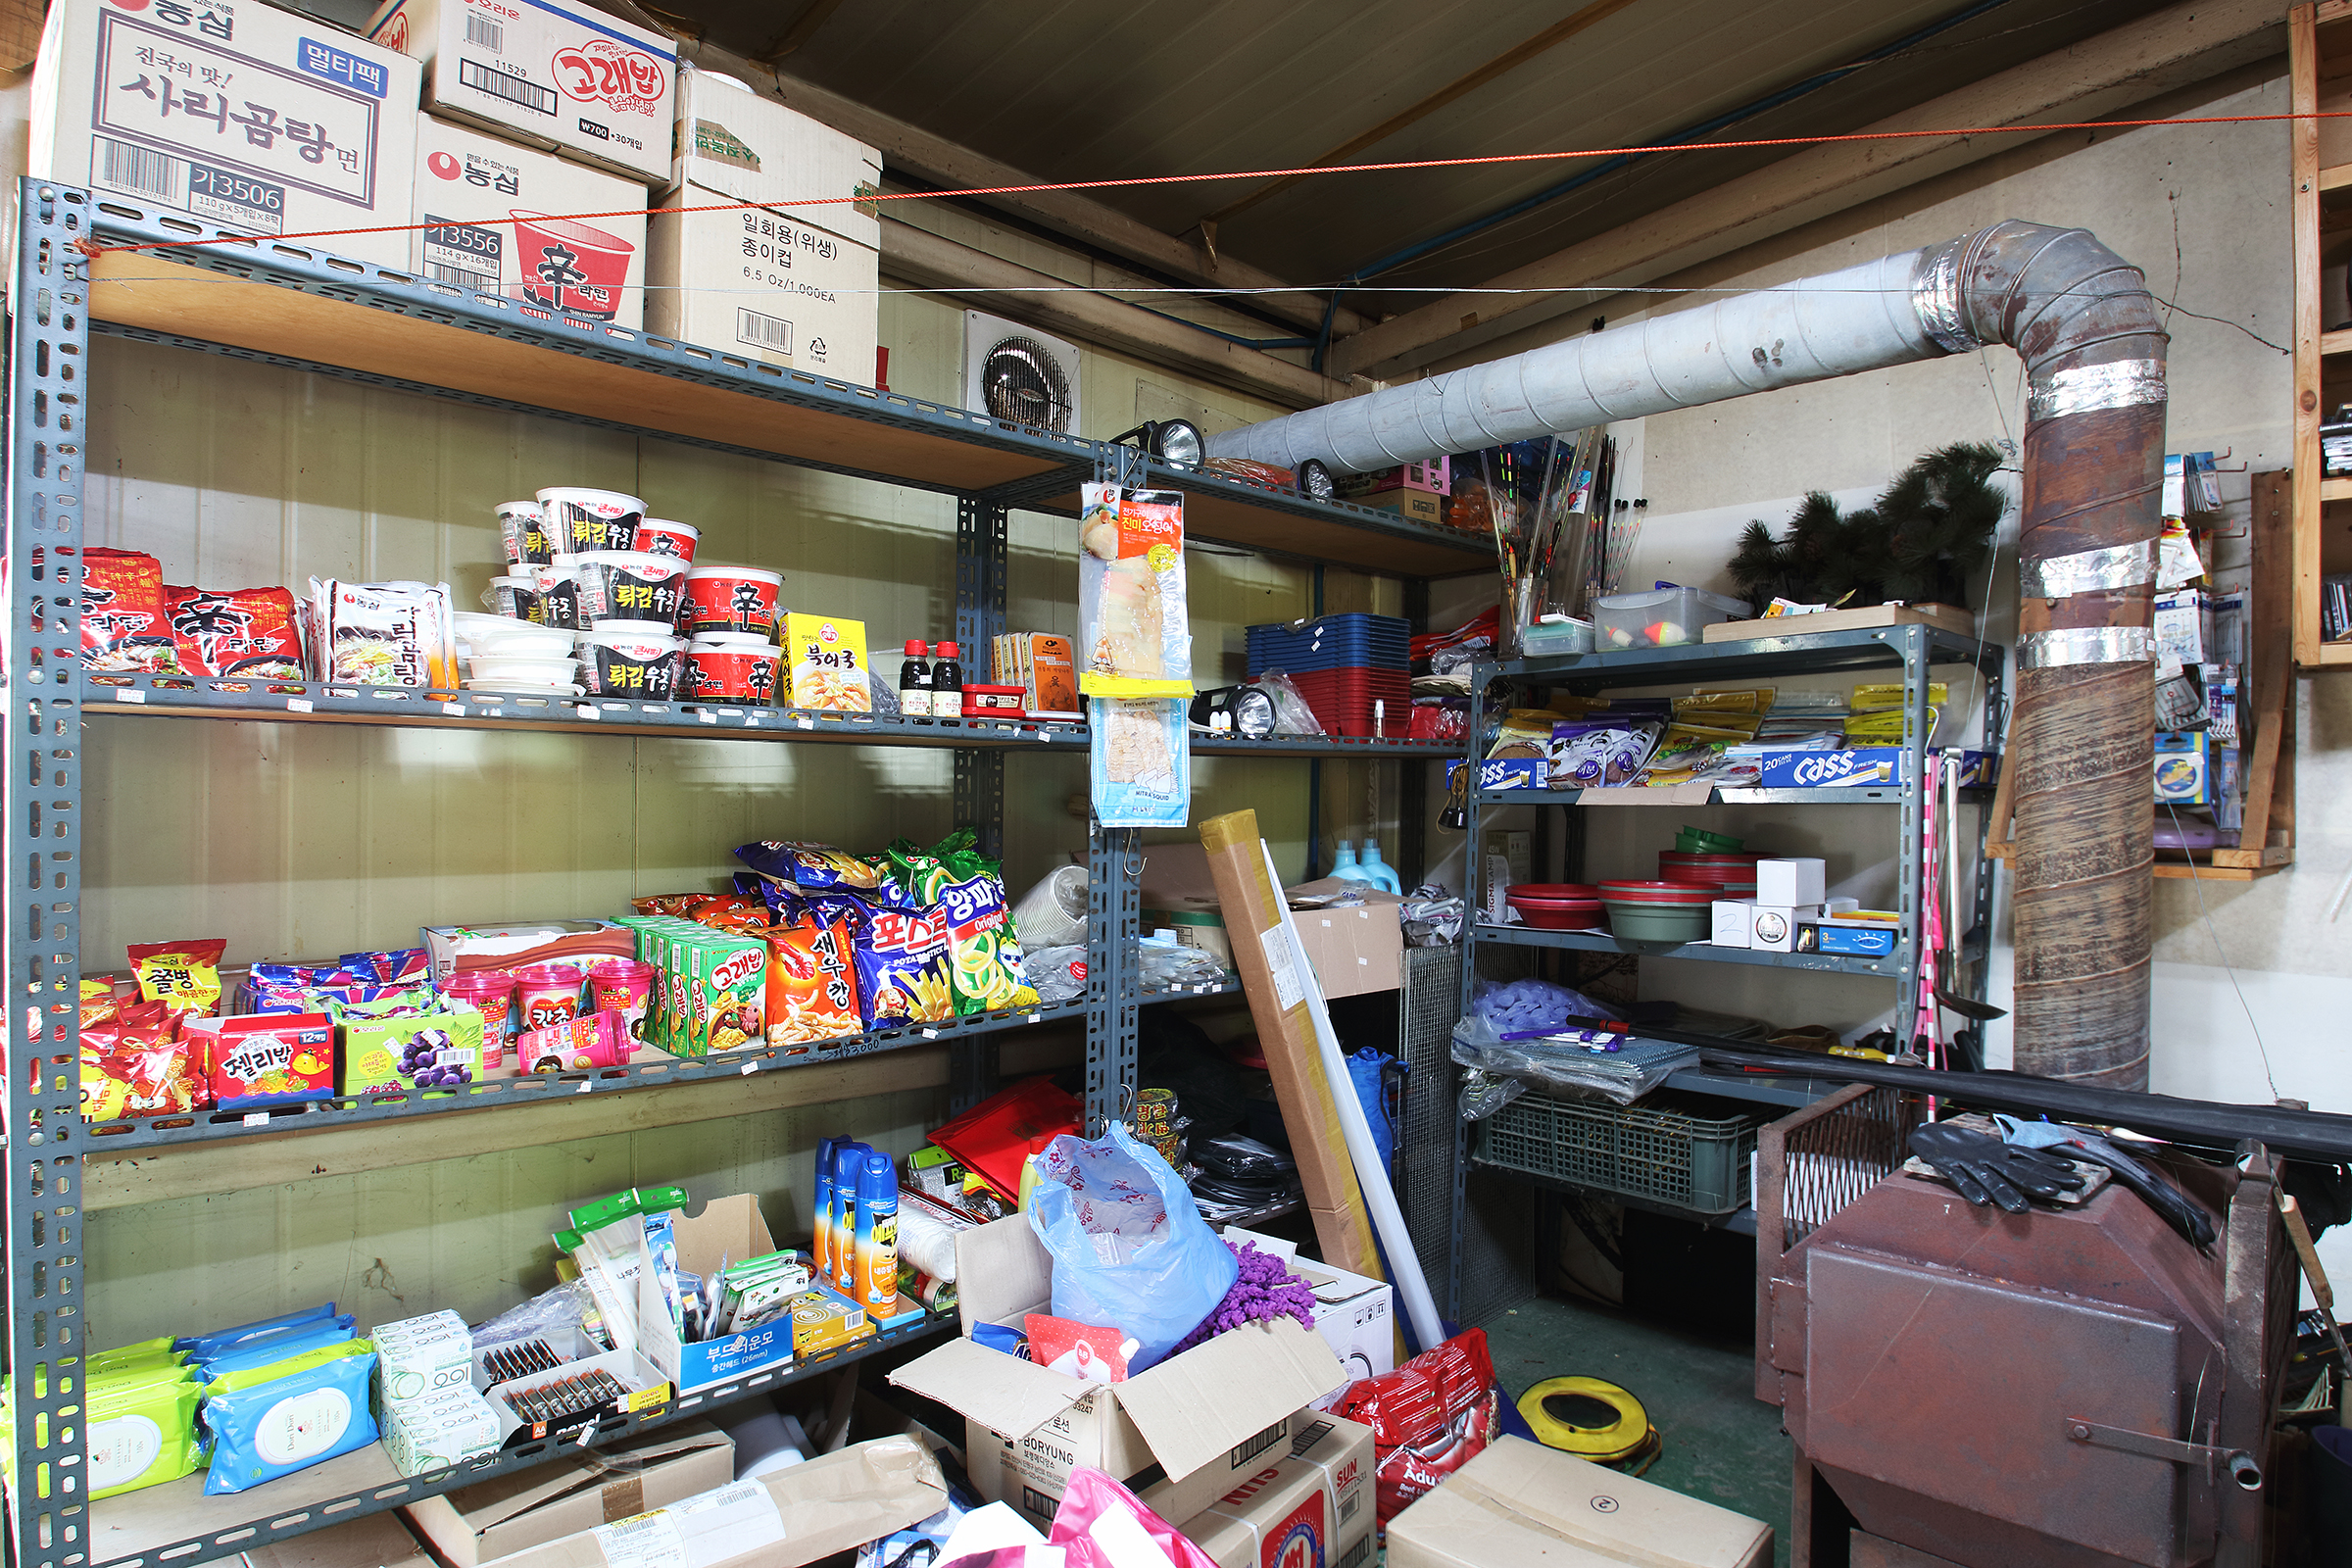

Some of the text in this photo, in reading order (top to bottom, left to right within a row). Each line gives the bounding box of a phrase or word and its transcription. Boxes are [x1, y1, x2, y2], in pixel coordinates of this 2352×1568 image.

[154, 0, 234, 41] 농심
[135, 46, 233, 89] 진국의 맛!
[306, 42, 381, 92] 멀티팩
[495, 60, 527, 77] 11529
[560, 56, 658, 95] 고래밥
[194, 169, 281, 210] 가3506
[465, 163, 519, 197] 농심
[199, 196, 218, 208] 110
[428, 220, 499, 255] 가3556
[436, 246, 454, 258] 114
[742, 213, 838, 261] 일회용(위생)
[742, 237, 792, 269] 종이컵
[743, 266, 762, 281] 6.5
[579, 285, 610, 303] 라면
[573, 521, 630, 552] 튀김우동
[615, 584, 675, 613] 튀김우동
[731, 583, 763, 630] 辛
[806, 644, 856, 669] 북어국
[608, 663, 669, 692] 튀김우동
[1764, 758, 1778, 771] 20
[974, 913, 1004, 932] Original
[1720, 912, 1743, 934] 2
[146, 967, 194, 995] 쫄병
[715, 951, 761, 986] 고래밥
[810, 931, 850, 1010] 새우깡
[177, 988, 219, 999] 매콤한 맛
[692, 982, 707, 1024] 고래밥
[301, 1031, 326, 1044] 12개입
[223, 1045, 294, 1077] 젤리밥
[741, 1348, 768, 1365] (26mm)
[1023, 1437, 1074, 1466] BORYUNG
[1337, 1457, 1357, 1489] SUN
